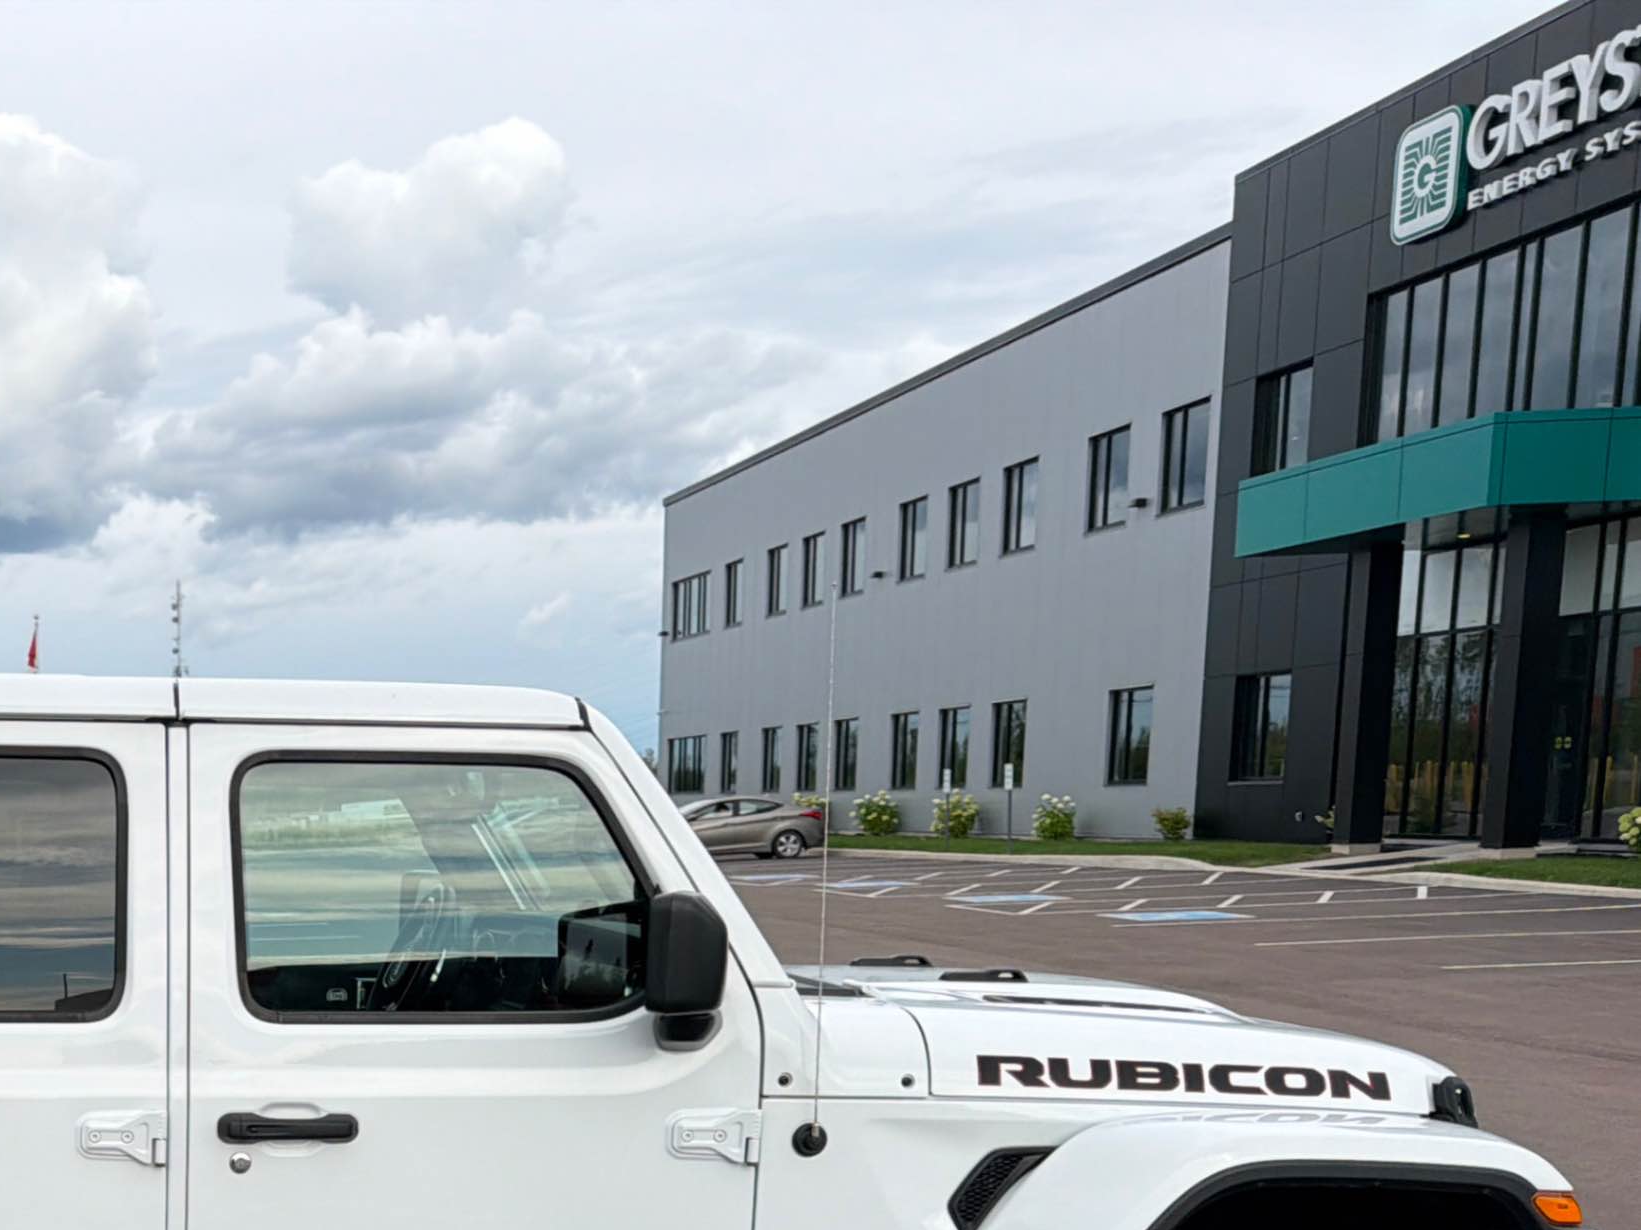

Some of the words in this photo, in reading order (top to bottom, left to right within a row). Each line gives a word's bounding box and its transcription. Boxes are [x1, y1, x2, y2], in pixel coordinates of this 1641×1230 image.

[1466, 24, 1641, 170] GREYS
[1466, 148, 1577, 210] ENERGY
[1584, 120, 1641, 161] SYS
[976, 1055, 1392, 1101] RUBICON
